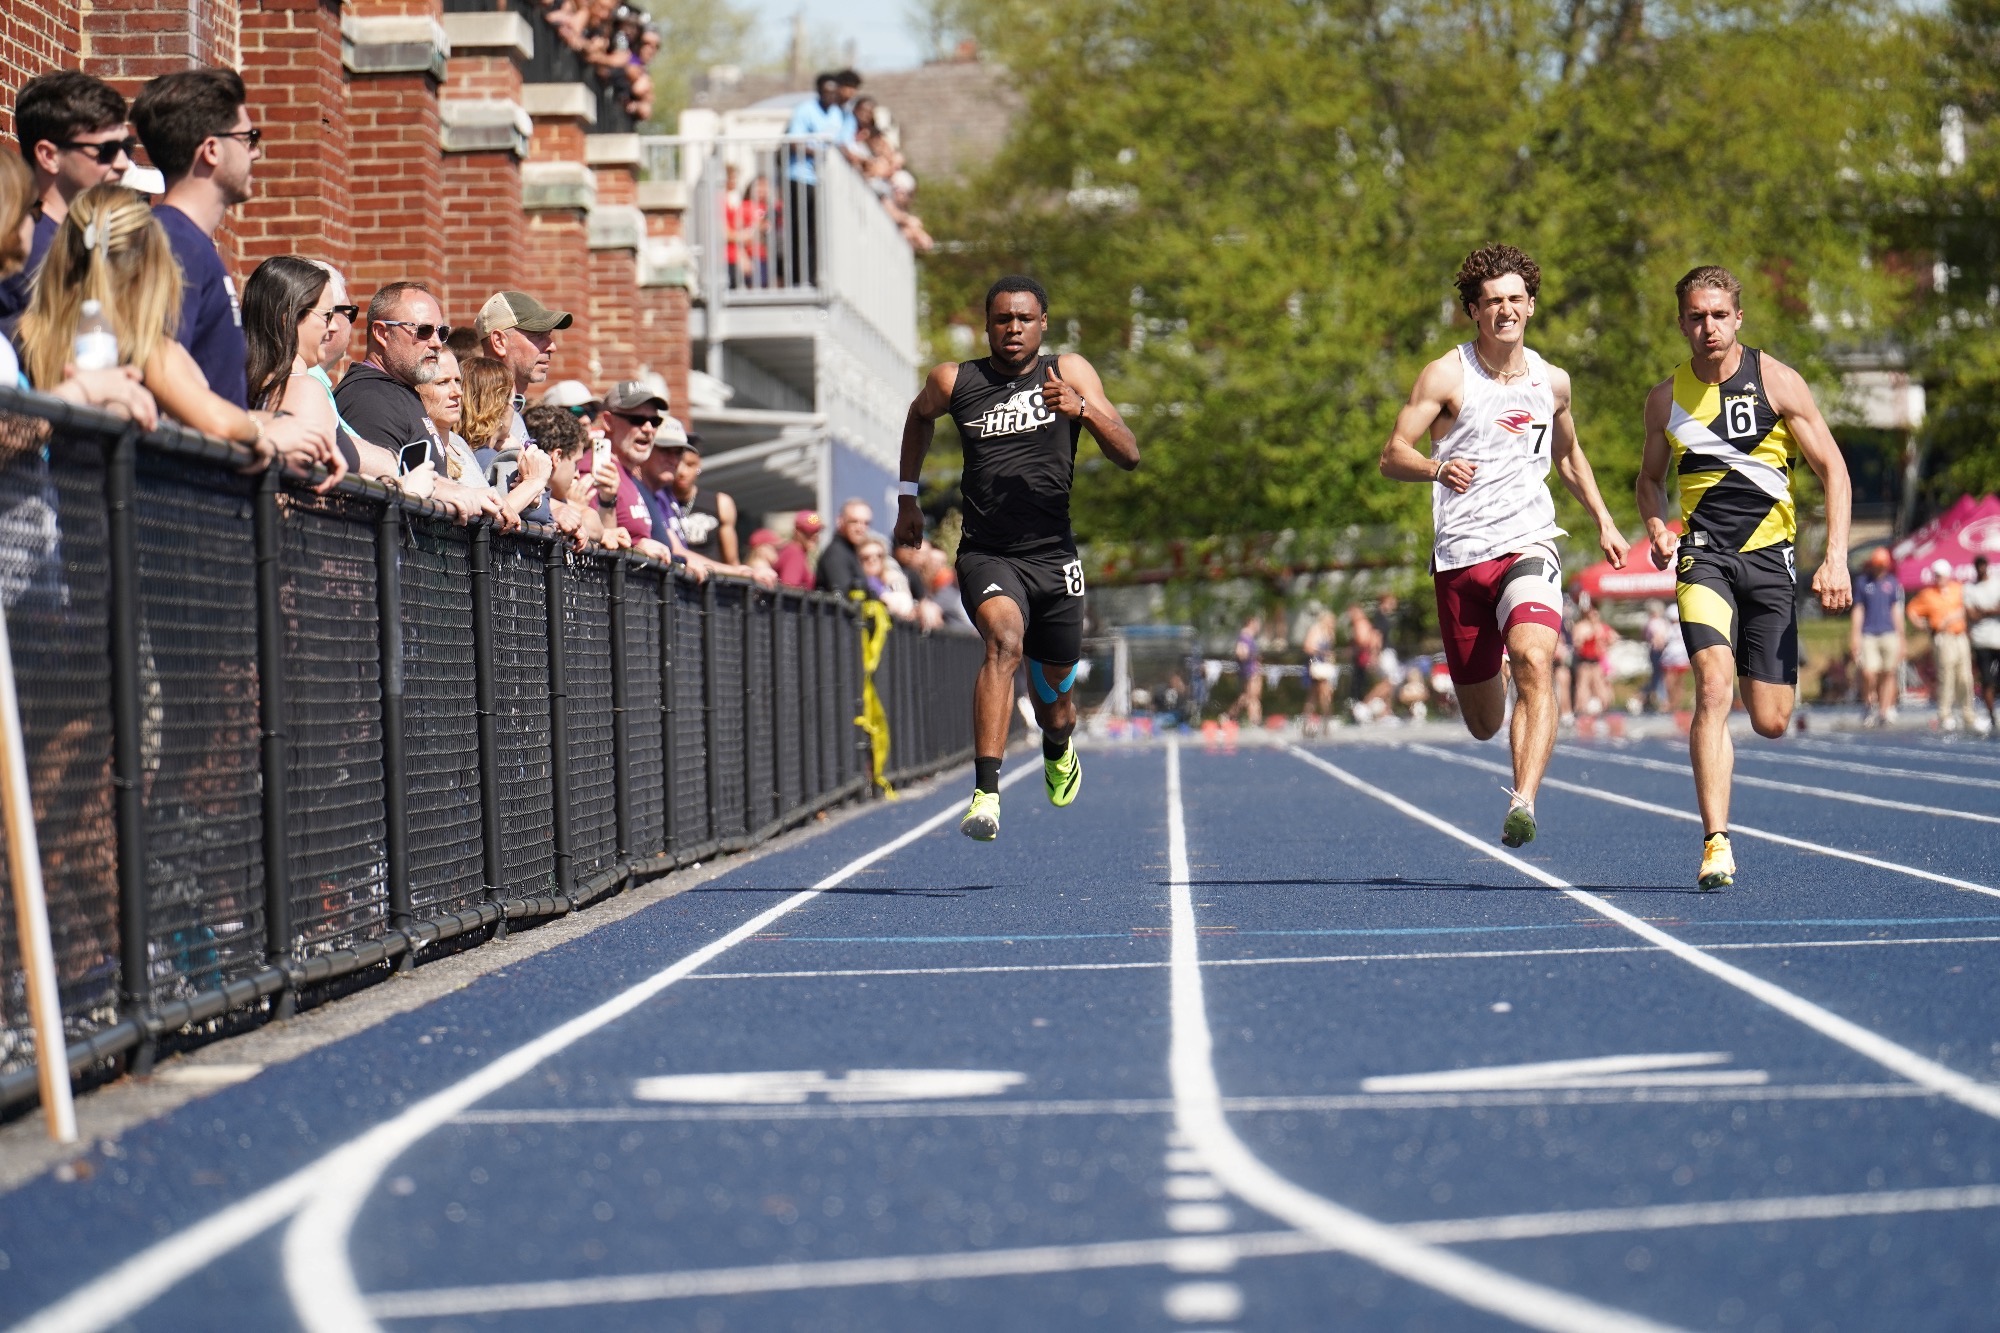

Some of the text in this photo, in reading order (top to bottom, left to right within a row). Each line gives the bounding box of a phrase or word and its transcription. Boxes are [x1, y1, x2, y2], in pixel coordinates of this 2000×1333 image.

[1028, 391, 1050, 421] 8
[1730, 401, 1752, 434] 6
[985, 410, 1032, 433] HFU
[1531, 424, 1547, 454] 7
[1069, 564, 1082, 594] 8
[1546, 559, 1559, 584] 7
